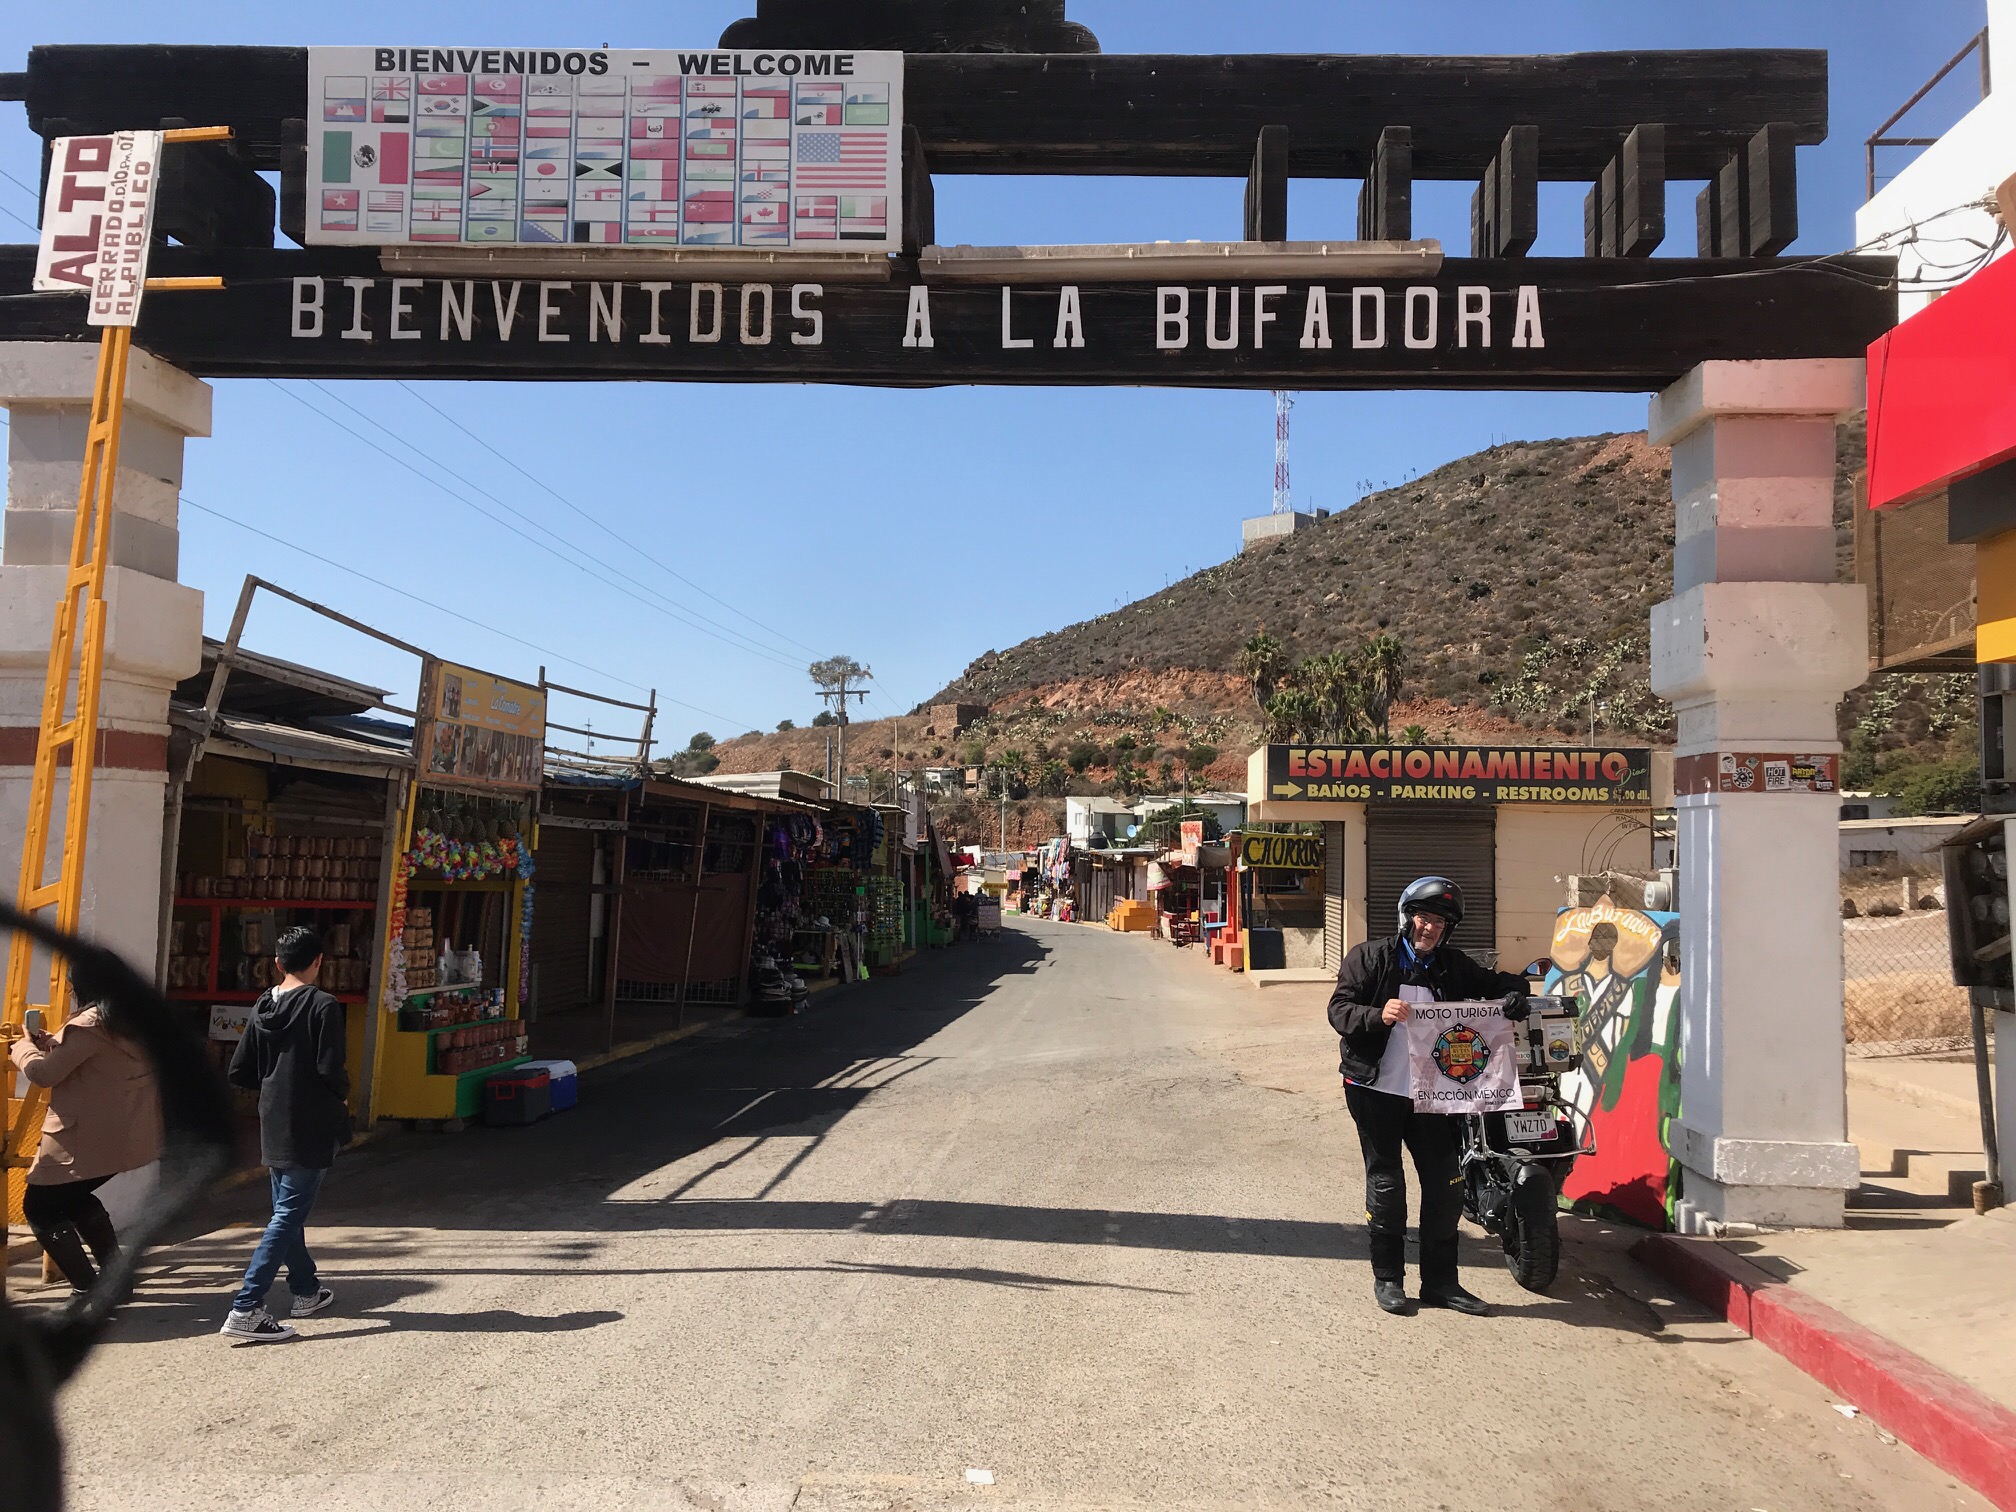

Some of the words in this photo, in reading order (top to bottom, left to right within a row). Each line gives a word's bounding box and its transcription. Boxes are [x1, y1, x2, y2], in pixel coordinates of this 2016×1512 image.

[374, 48, 609, 75] BIENVENIDOS
[677, 53, 855, 76] WELCOME
[48, 137, 114, 287] ALTO
[94, 199, 125, 315] CERRADO
[290, 275, 825, 346] BIENVENIDOS
[902, 285, 935, 348] A
[1001, 285, 1085, 349] LA
[1156, 285, 1546, 350] BUFADORA
[1288, 749, 1630, 781] ESTACIONAMIENTO
[1767, 767, 1784, 776] HOT
[1307, 780, 1371, 798] BAÑOS
[1391, 785, 1477, 800] PARKING
[1496, 786, 1610, 801] RESTROOMS
[1767, 776, 1785, 785] FIRE
[1242, 836, 1321, 867] CHURROS
[1415, 1008, 1452, 1020] MOTO
[1454, 1006, 1501, 1019] TURISTA
[1417, 1090, 1430, 1100] EN
[1432, 1088, 1472, 1101] ACCIÓN
[1474, 1087, 1516, 1099] MÉXICO
